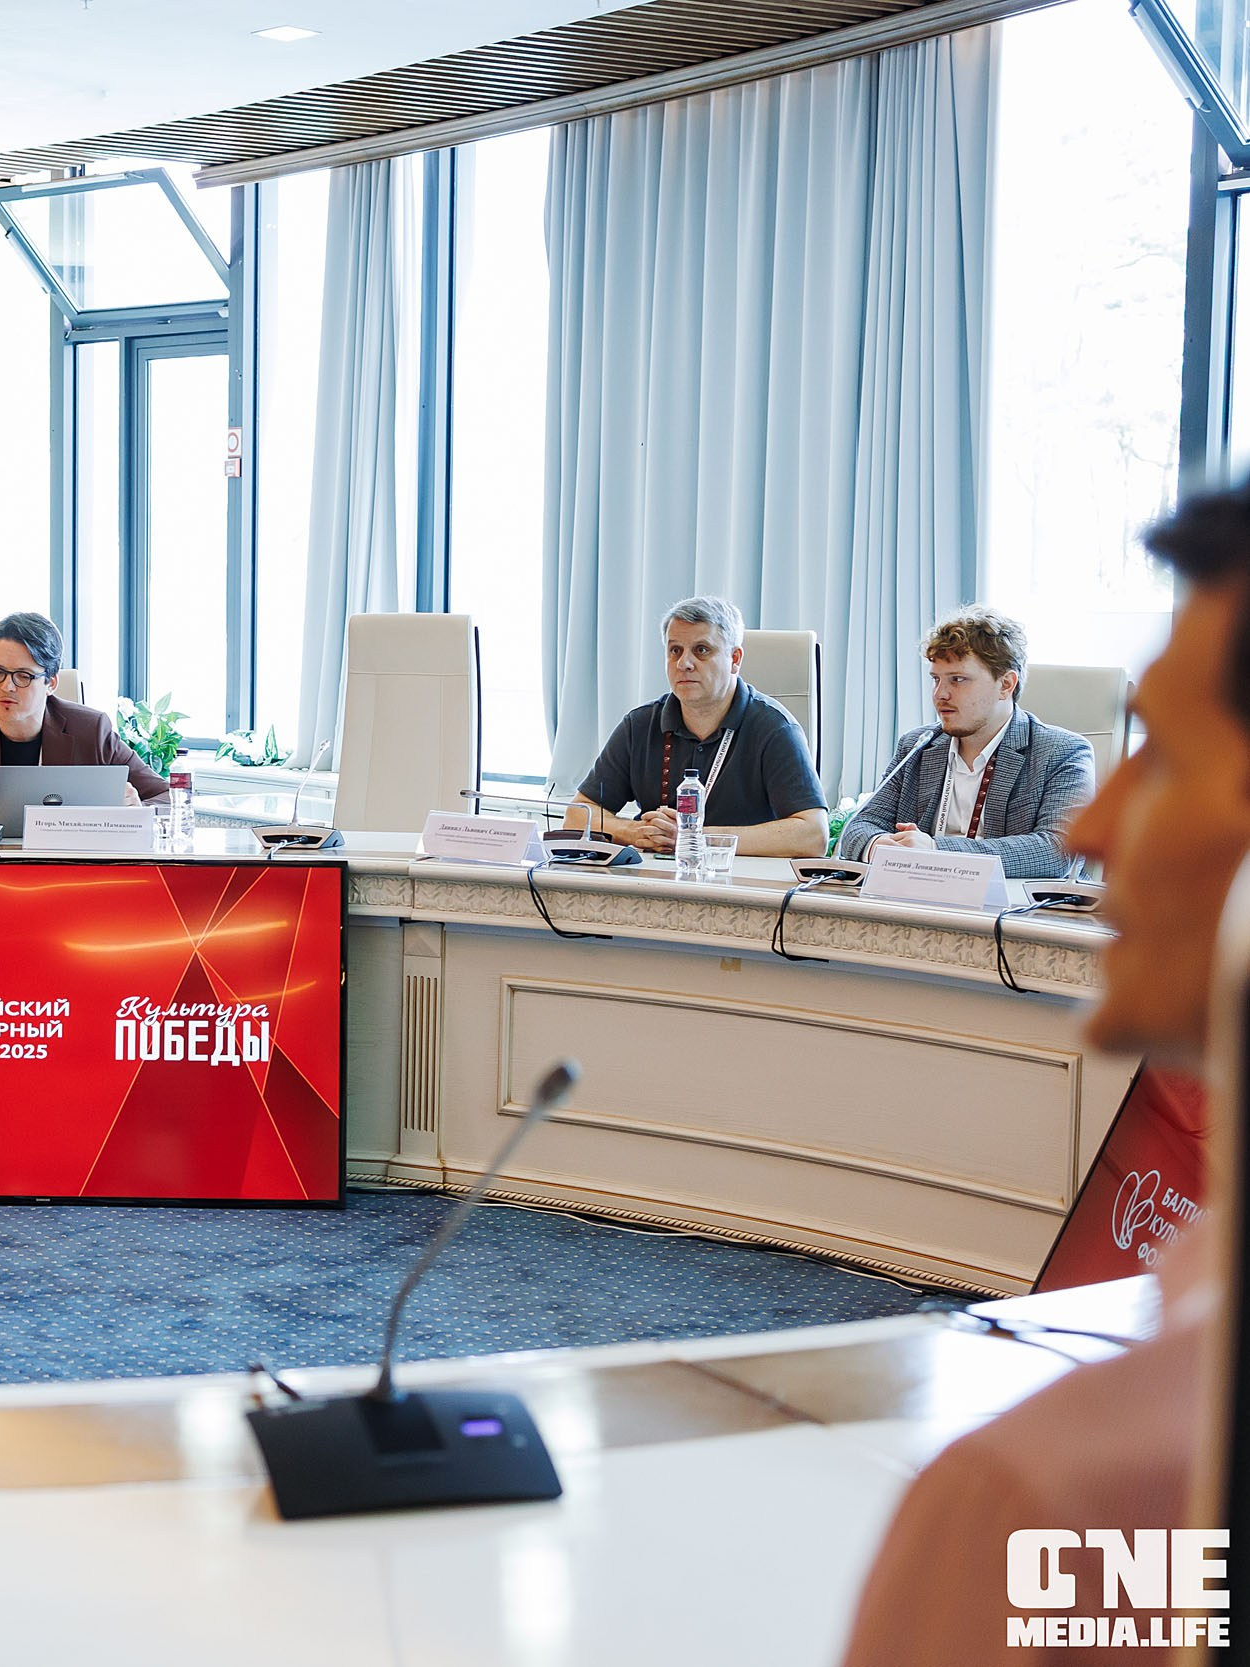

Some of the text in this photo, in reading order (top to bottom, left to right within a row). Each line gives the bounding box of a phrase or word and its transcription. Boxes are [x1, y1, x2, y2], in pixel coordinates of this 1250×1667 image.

[35, 820, 56, 828] Игорь
[115, 996, 270, 1026] Культура
[0, 1043, 48, 1059] 2025
[115, 1019, 270, 1067] ПОБЕДЫ
[1161, 1187, 1207, 1224] БАЛТИ
